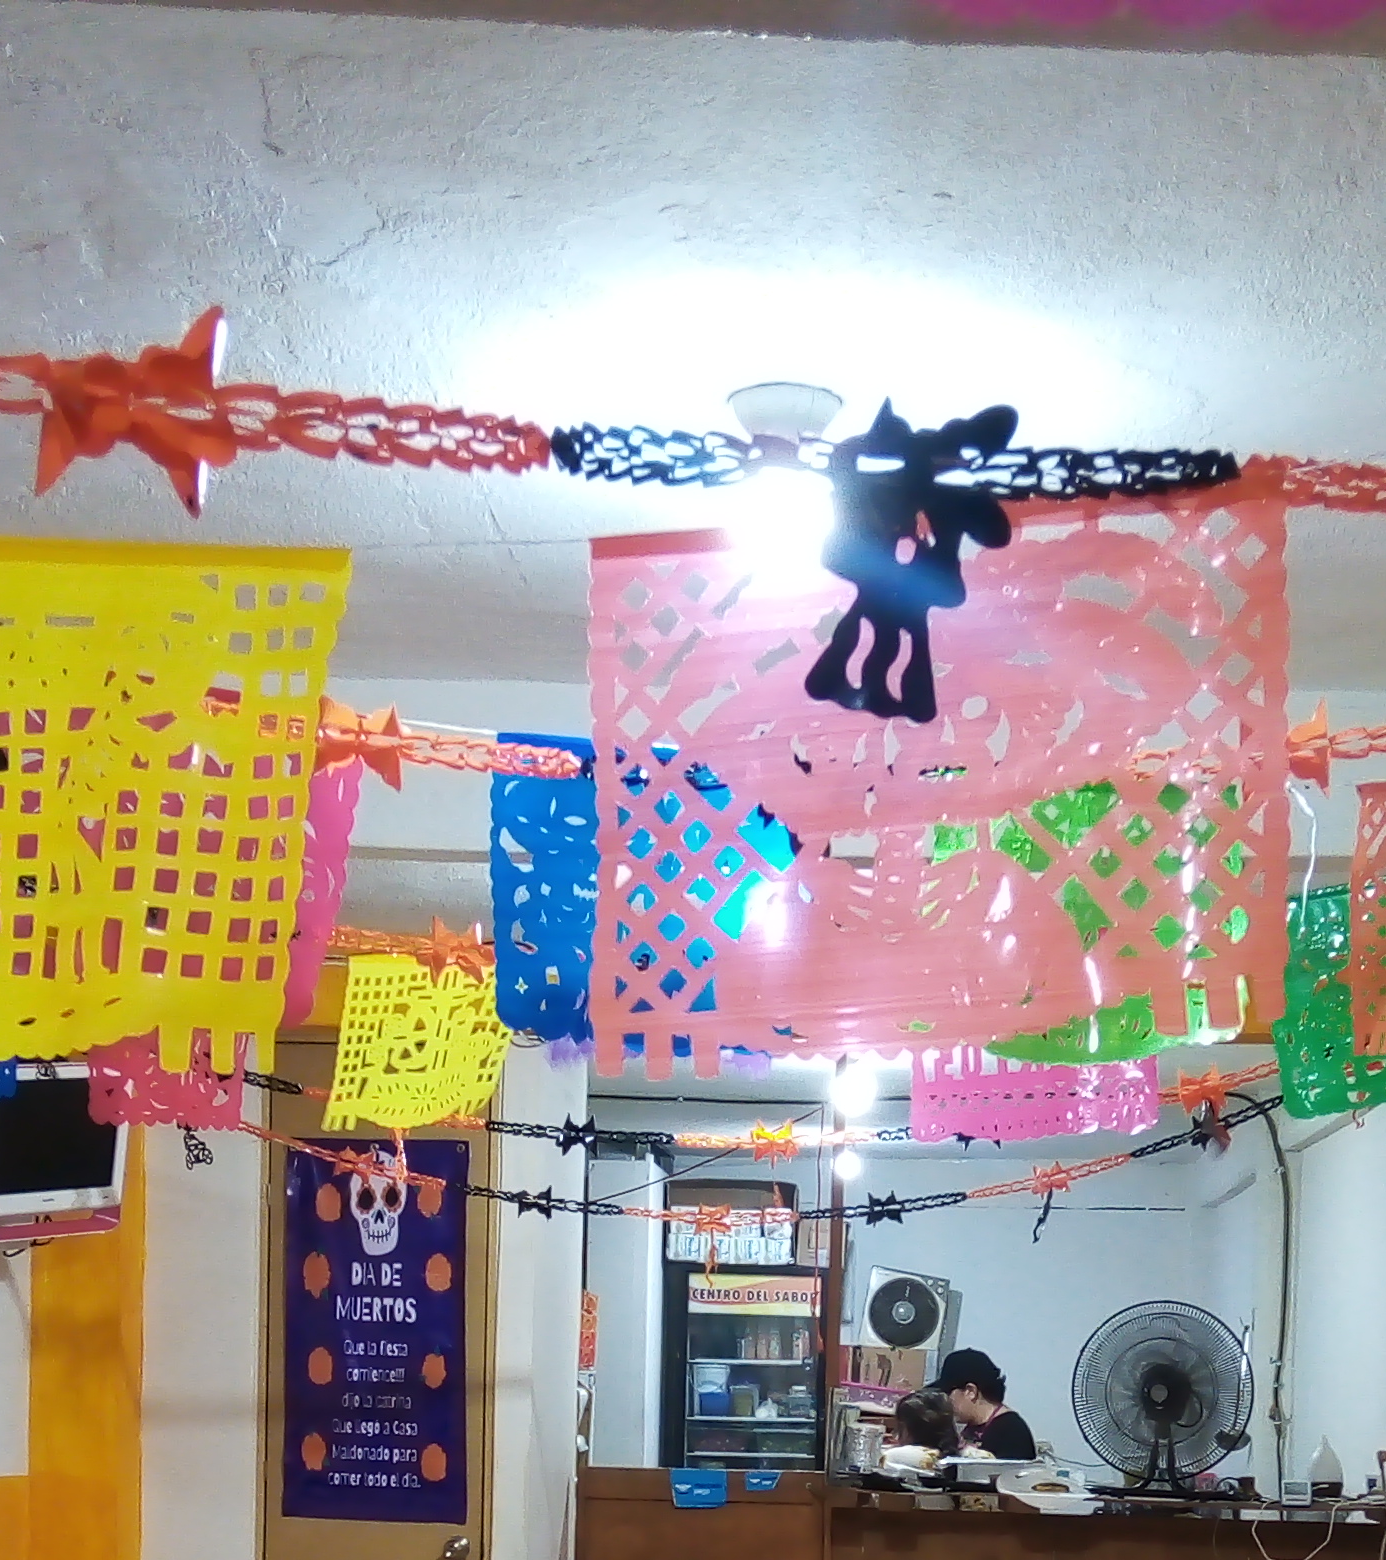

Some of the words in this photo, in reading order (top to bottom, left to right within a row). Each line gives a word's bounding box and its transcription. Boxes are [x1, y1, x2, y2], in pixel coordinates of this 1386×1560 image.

[381, 1262, 403, 1287] DE
[692, 1289, 741, 1301] CENTRO
[747, 1290, 769, 1302] DEL
[335, 1294, 418, 1324] MUERTOS
[343, 1339, 366, 1356] Que
[392, 1420, 419, 1437] Casa
[332, 1443, 391, 1461] Maldonado
[392, 1447, 418, 1464] para
[363, 1471, 389, 1488] todo
[390, 1472, 400, 1488] el
